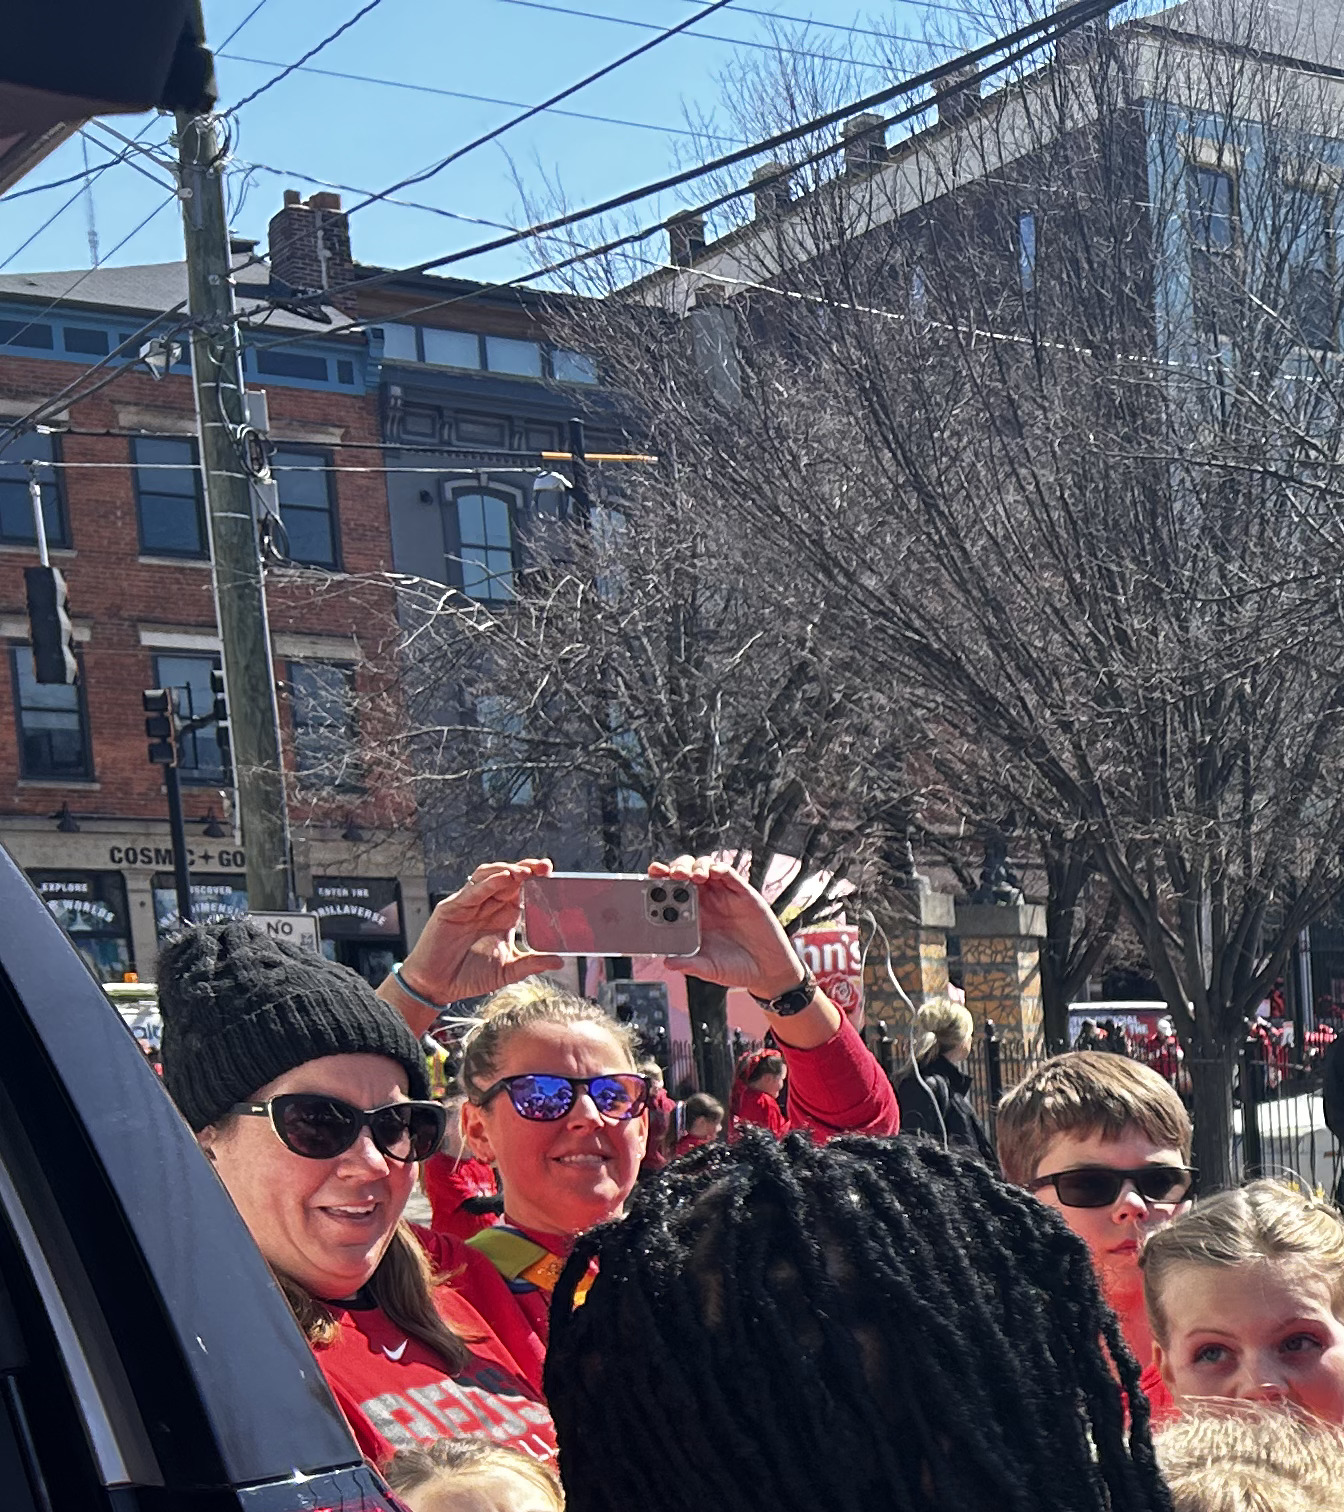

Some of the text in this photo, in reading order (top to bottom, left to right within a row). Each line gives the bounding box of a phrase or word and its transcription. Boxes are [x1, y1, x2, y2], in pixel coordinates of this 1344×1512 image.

[109, 845, 196, 867] COSMC
[41, 882, 88, 893] EXPLORE
[317, 887, 370, 898] ENTER THE
[267, 920, 293, 936] NO
